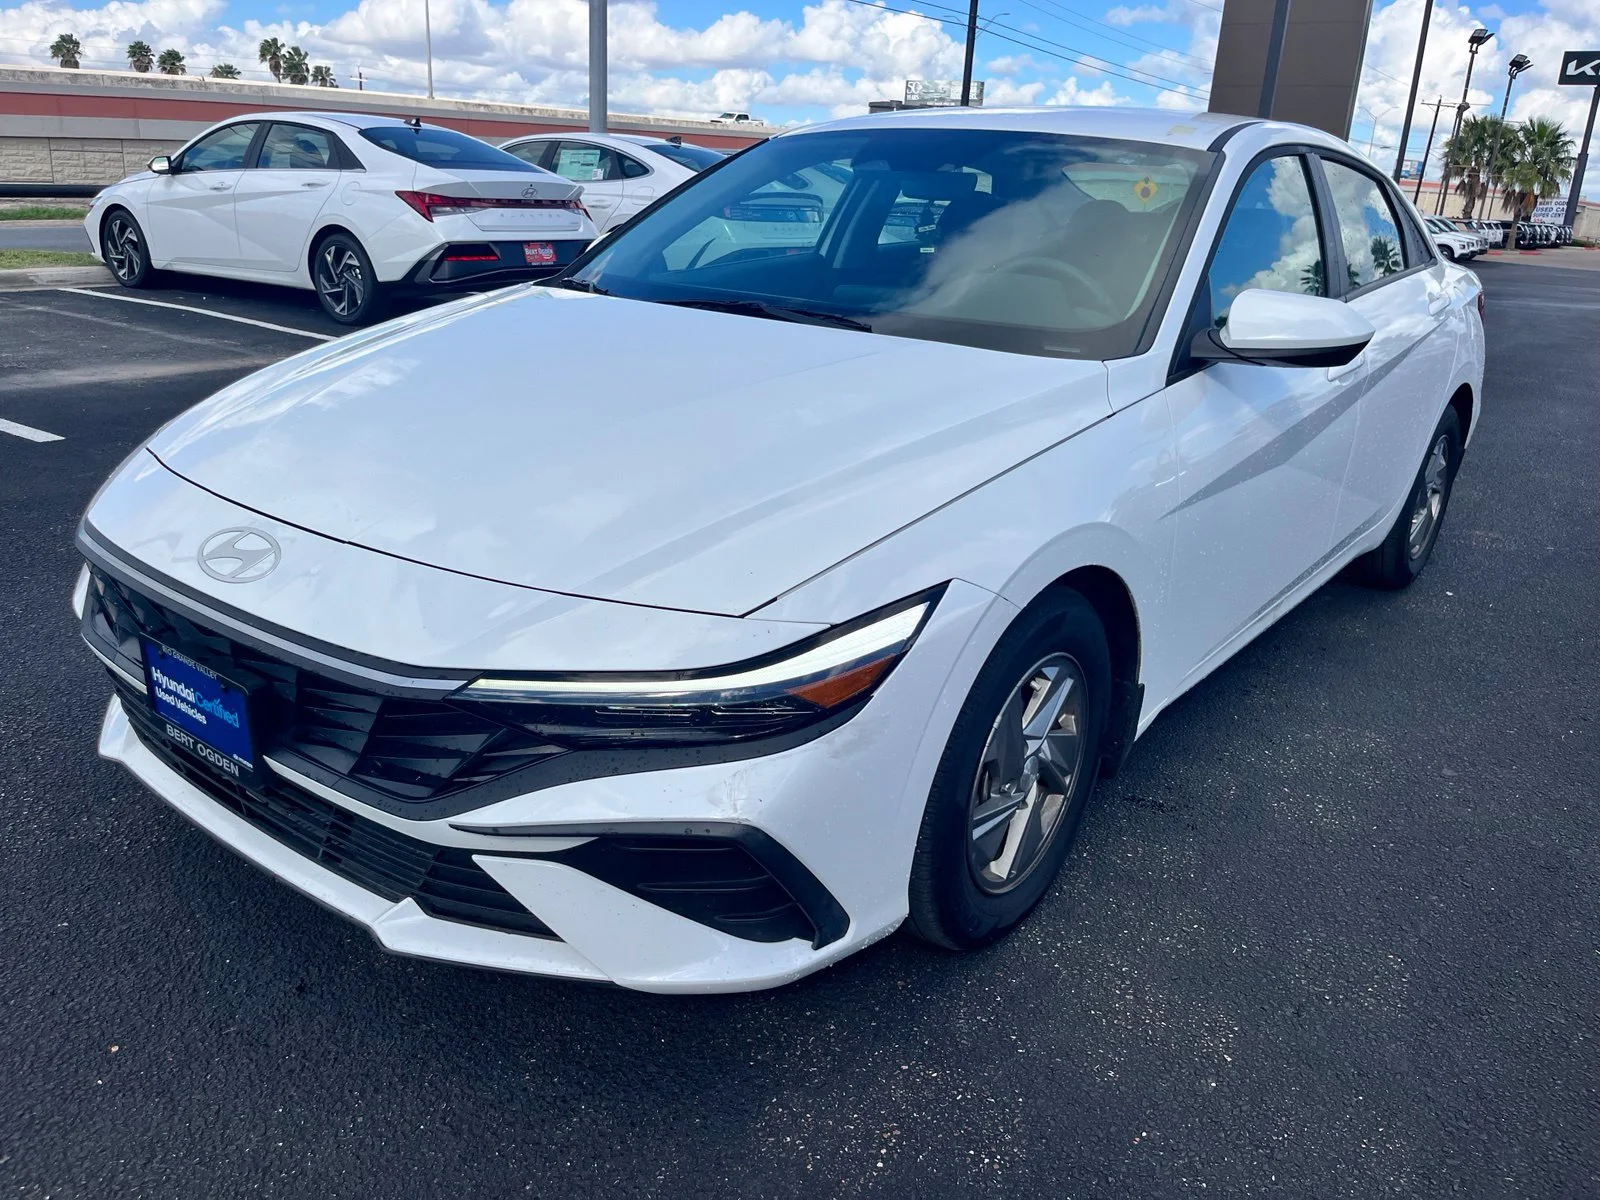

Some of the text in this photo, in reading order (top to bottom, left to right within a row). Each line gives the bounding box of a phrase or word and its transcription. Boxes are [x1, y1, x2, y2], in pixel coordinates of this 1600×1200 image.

[195, 663, 217, 680] VALLEY
[152, 666, 239, 728] Hyundai Certified
[155, 686, 207, 724] Used Vehicles
[166, 723, 194, 749] BERT
[197, 743, 239, 776] OGDEN
